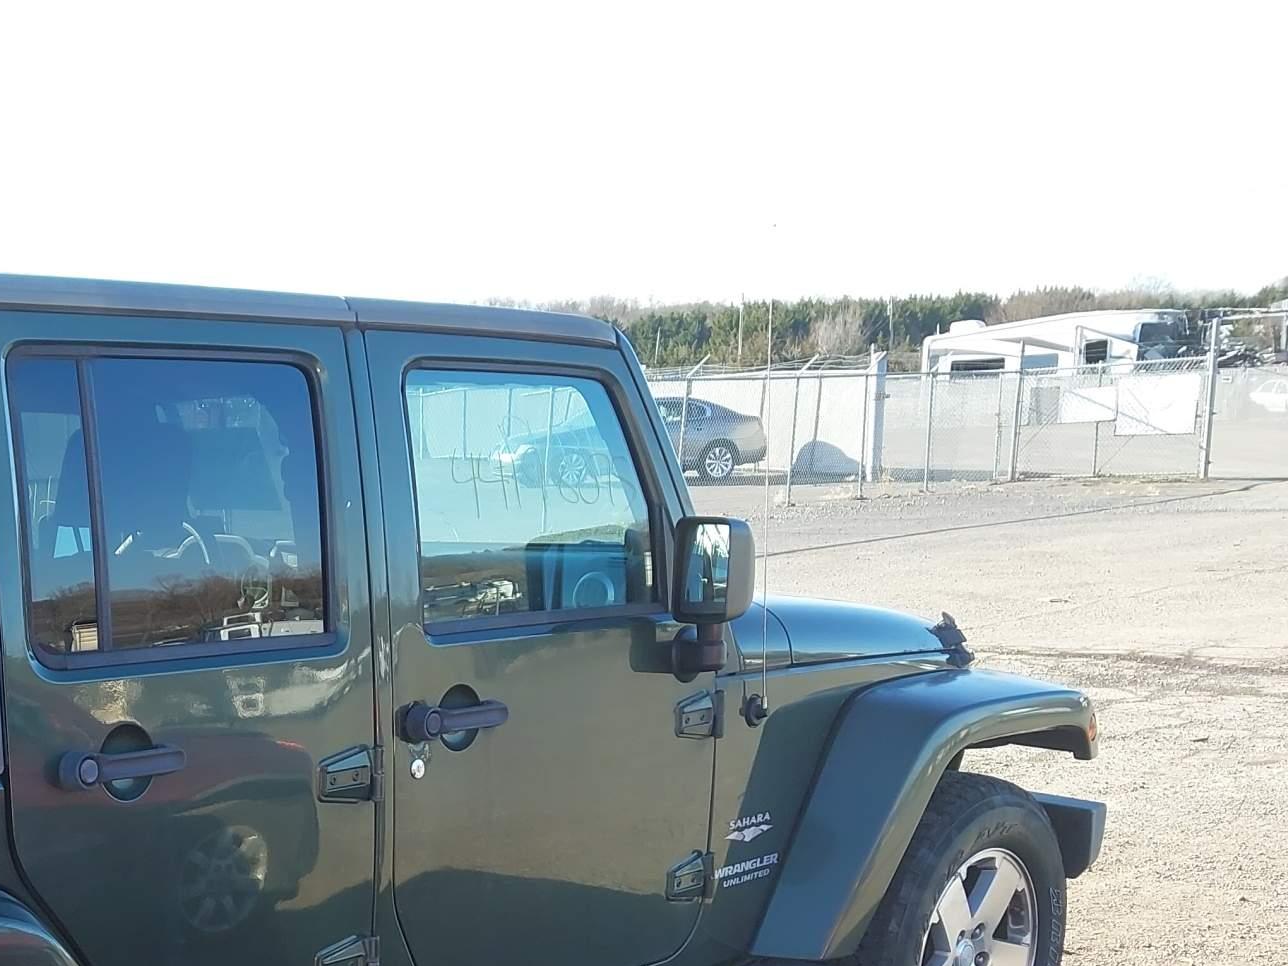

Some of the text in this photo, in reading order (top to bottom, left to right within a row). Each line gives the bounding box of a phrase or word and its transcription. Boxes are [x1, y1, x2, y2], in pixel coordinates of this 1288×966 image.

[729, 811, 771, 830] SAHARA
[714, 852, 779, 879] WRANGLER
[723, 868, 770, 888] UNLIMITED
